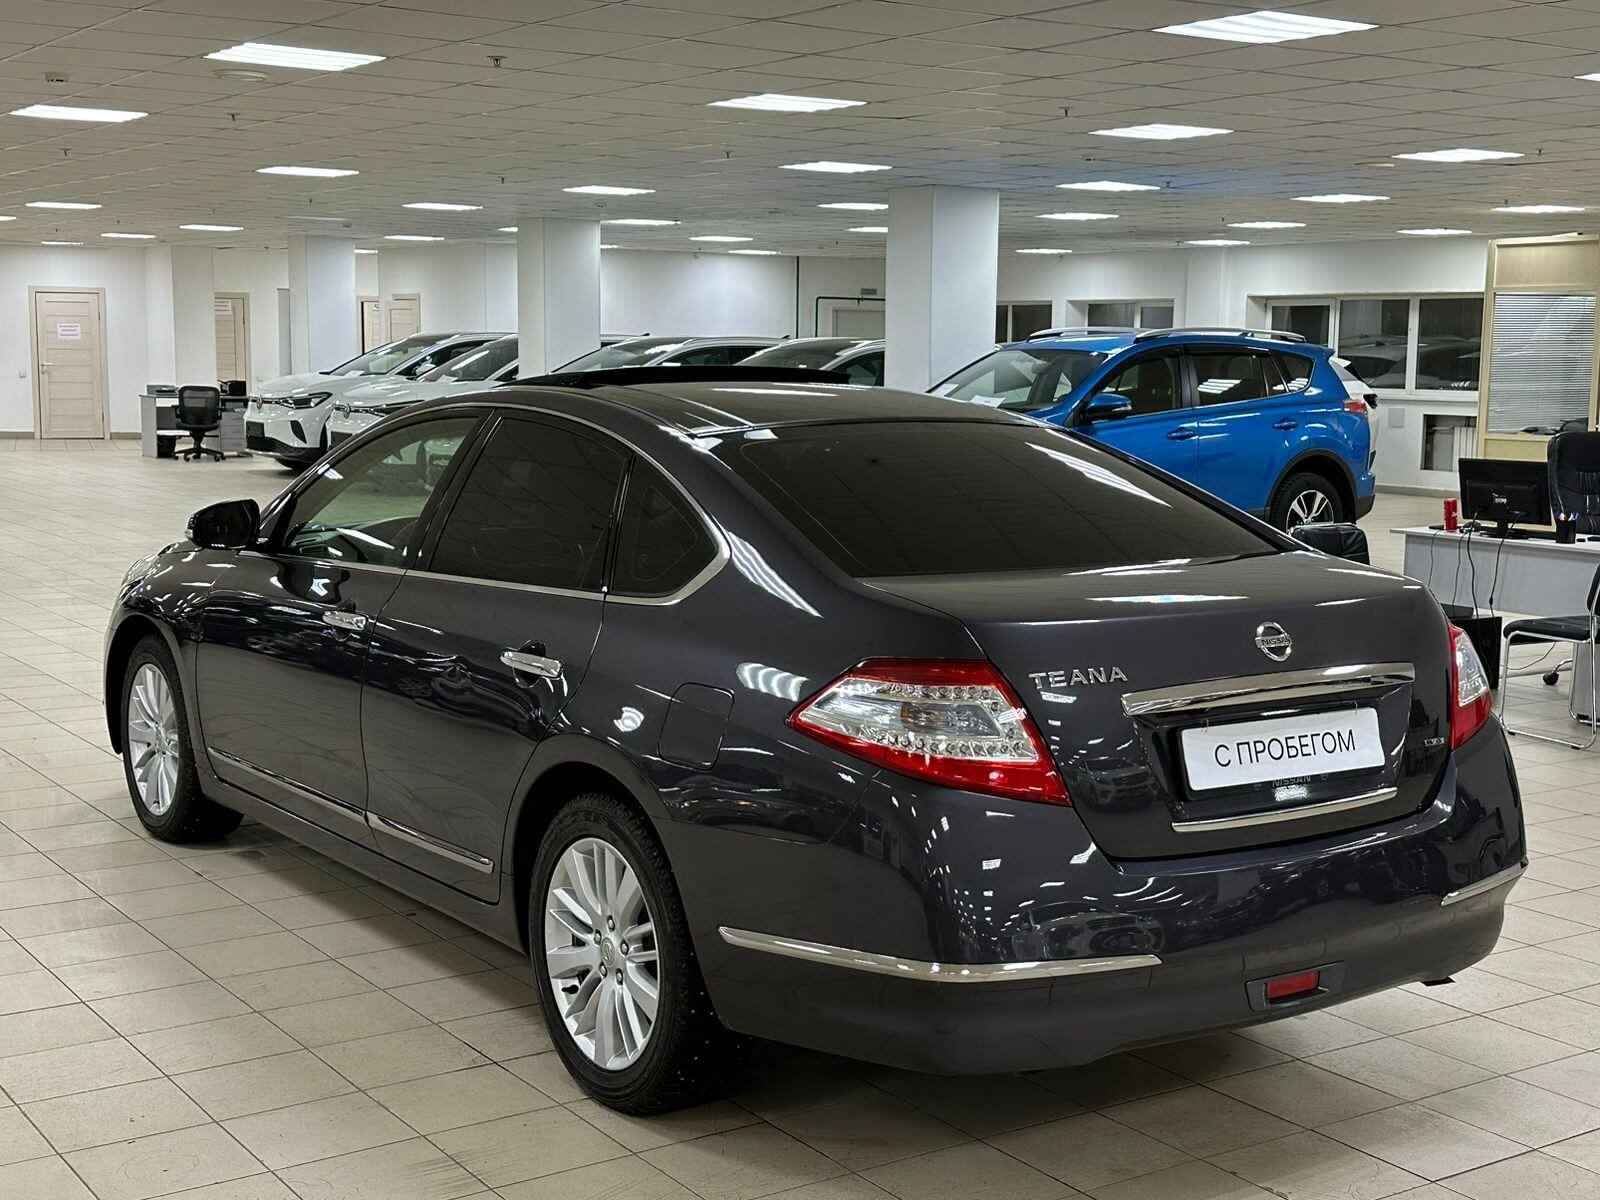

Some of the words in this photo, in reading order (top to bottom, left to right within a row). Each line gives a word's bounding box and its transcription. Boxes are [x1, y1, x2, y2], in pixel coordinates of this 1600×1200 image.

[1028, 666, 1128, 689] TEANA
[1214, 744, 1231, 767] С
[1236, 729, 1356, 765] ПРОБЕГОМ
